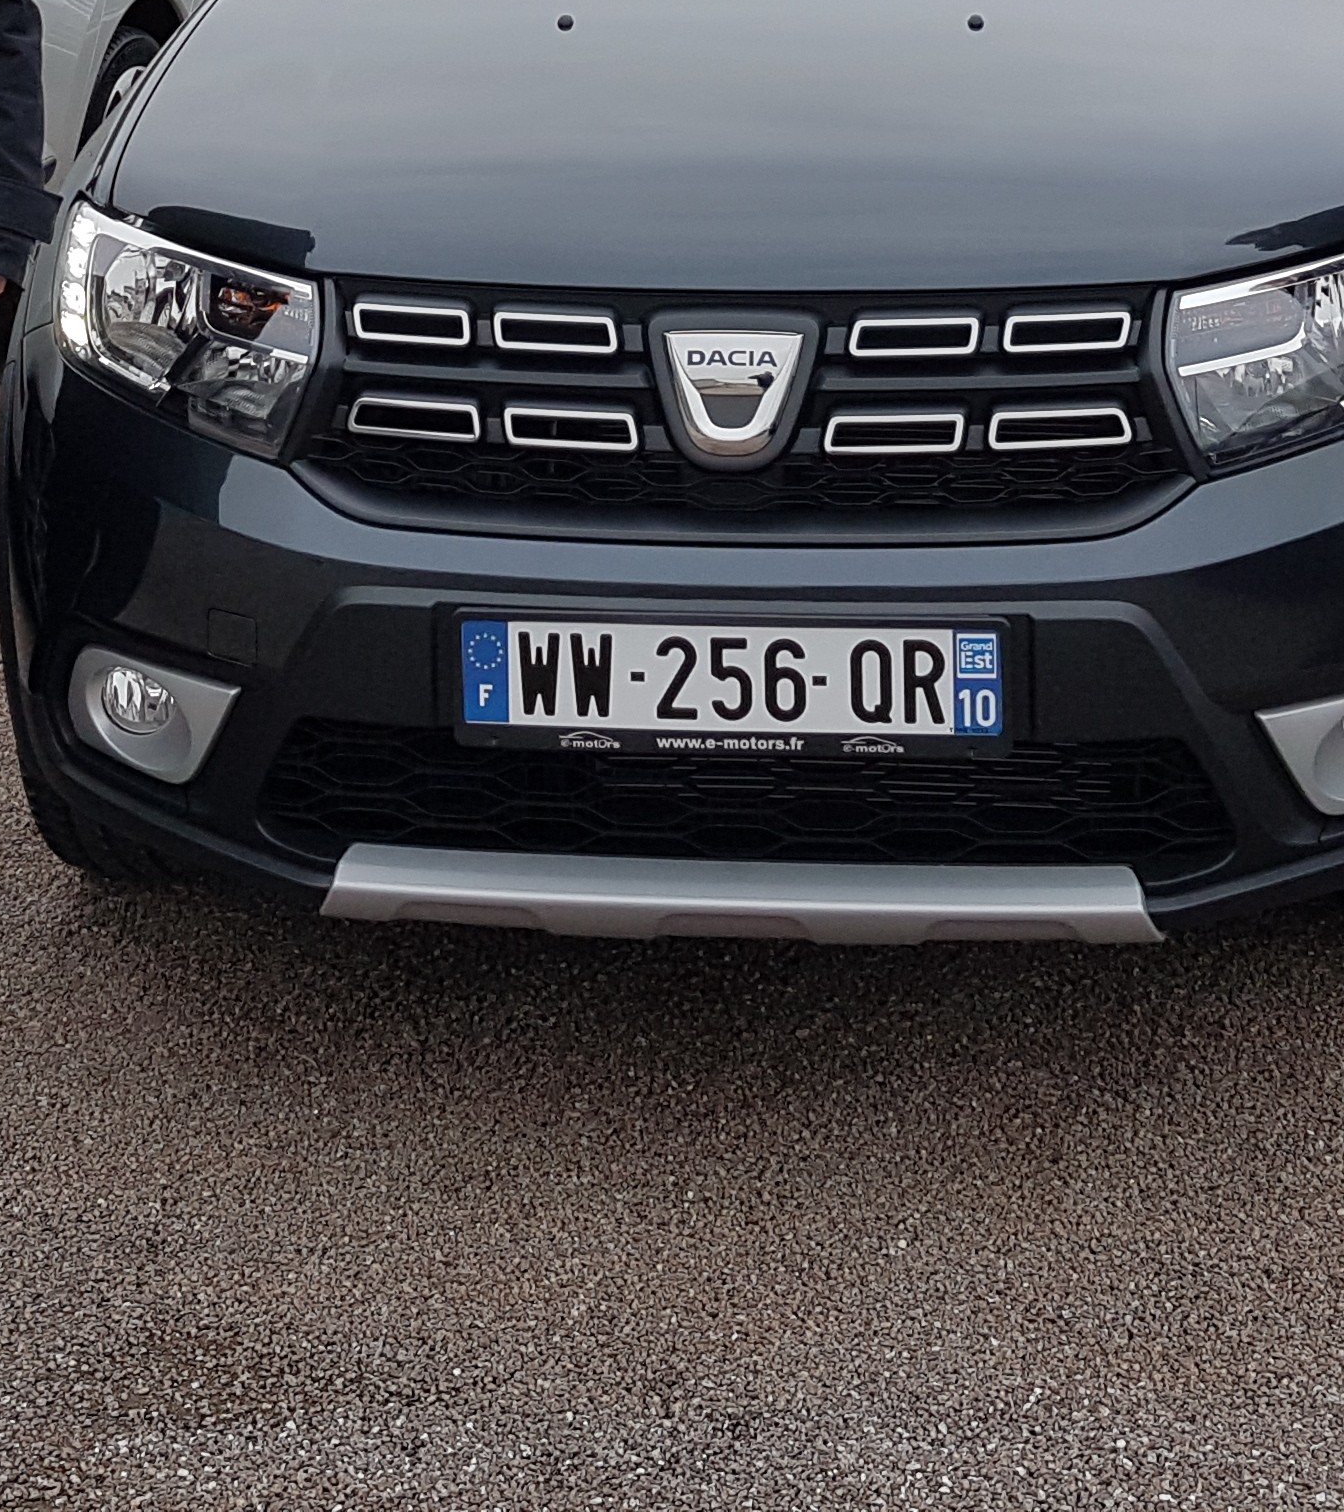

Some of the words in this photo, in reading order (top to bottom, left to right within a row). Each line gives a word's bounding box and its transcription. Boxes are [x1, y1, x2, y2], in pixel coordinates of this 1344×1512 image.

[687, 350, 778, 367] DACIA
[960, 641, 993, 651] Grand
[960, 652, 993, 668] Est
[479, 684, 493, 706] F
[958, 689, 996, 727] 10
[656, 736, 805, 751] www.e-motors.fr
